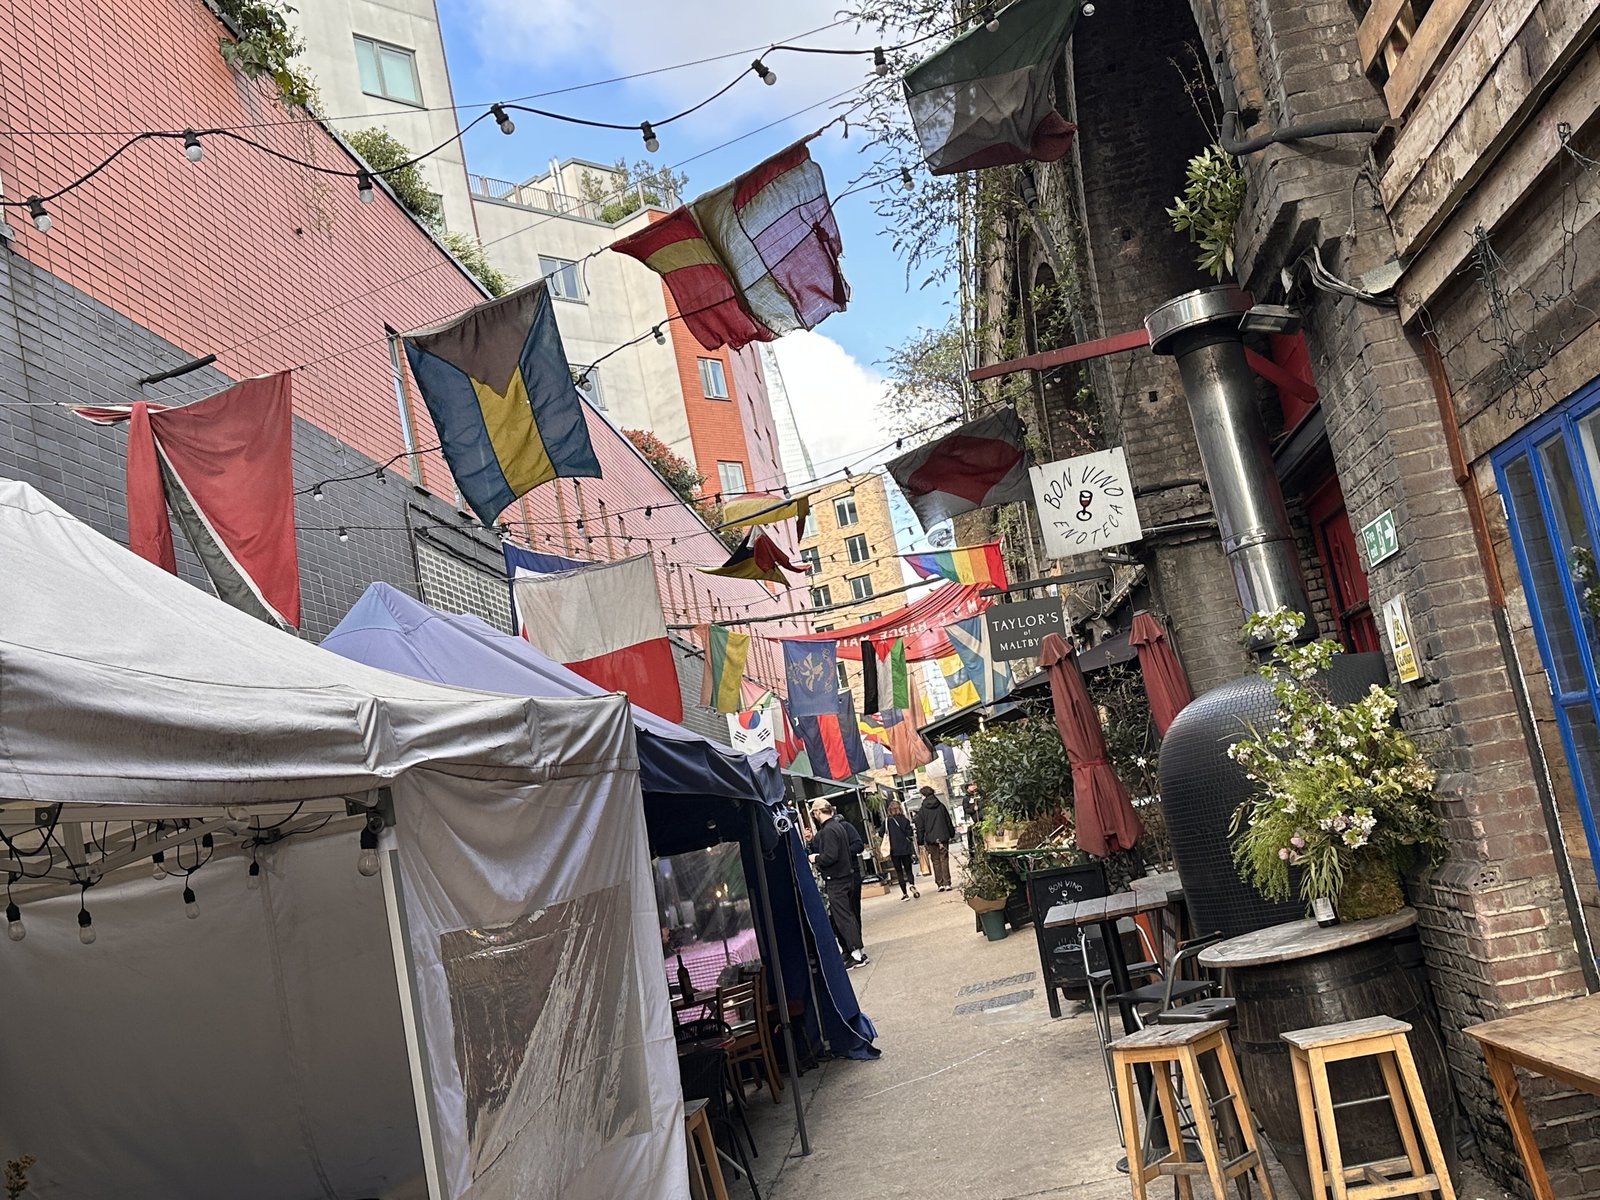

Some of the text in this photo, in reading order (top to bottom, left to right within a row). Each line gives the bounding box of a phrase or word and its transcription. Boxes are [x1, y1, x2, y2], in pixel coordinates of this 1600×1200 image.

[1044, 466, 1124, 509] BON VINO
[1053, 504, 1123, 544] ENOTECA
[992, 612, 1059, 631] TAYLOR'S
[1000, 638, 1039, 651] MALTBY
[1048, 880, 1083, 893] BON VINO
